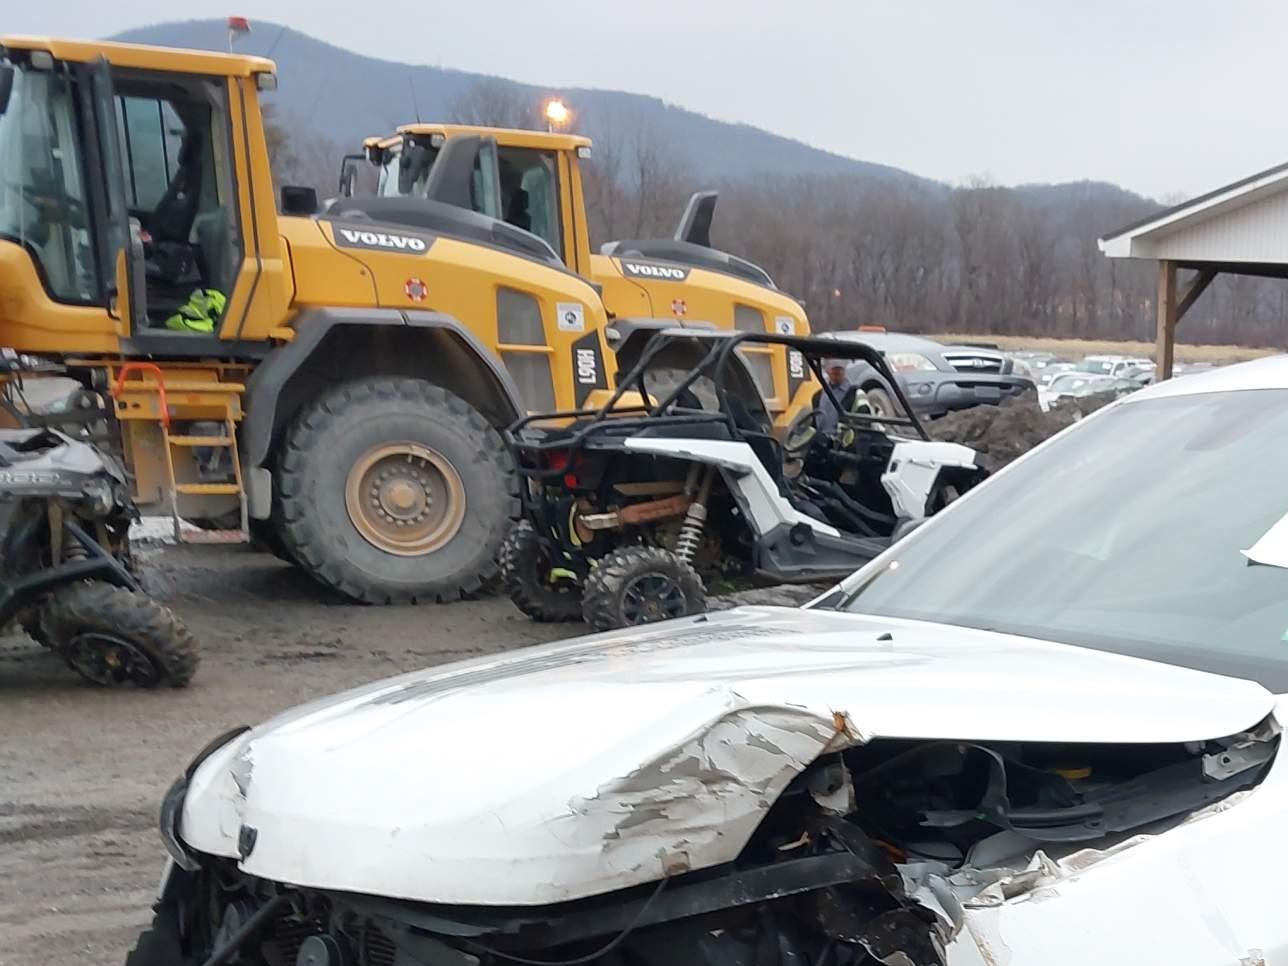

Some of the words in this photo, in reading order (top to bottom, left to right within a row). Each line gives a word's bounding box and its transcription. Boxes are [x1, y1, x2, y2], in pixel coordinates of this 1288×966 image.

[340, 229, 426, 251] VOLVO
[625, 263, 685, 279] VOLVO
[577, 348, 597, 384] L90H
